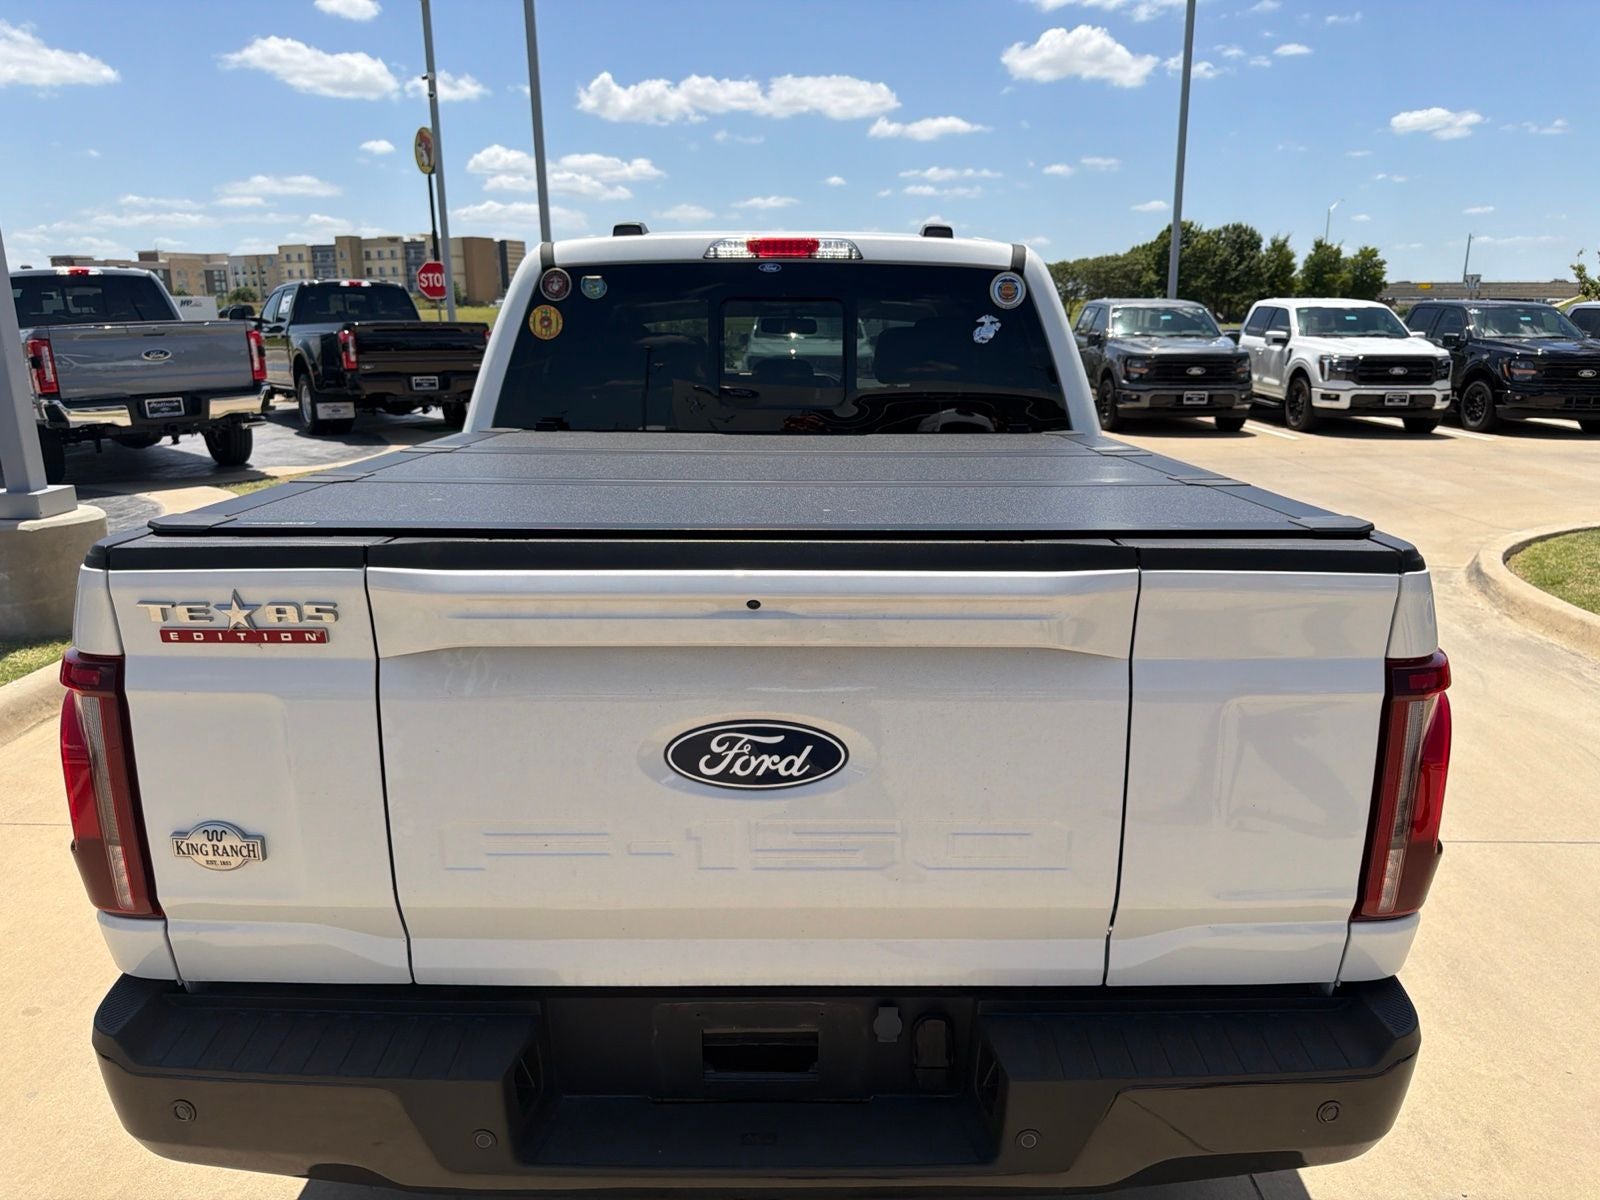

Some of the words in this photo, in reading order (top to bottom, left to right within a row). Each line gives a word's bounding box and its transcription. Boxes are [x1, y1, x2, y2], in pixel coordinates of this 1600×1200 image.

[169, 632, 317, 642] EDITION
[698, 732, 814, 776] Ford
[175, 840, 209, 857] KING
[211, 843, 257, 858] RANCH
[439, 819, 1073, 871] F-150
